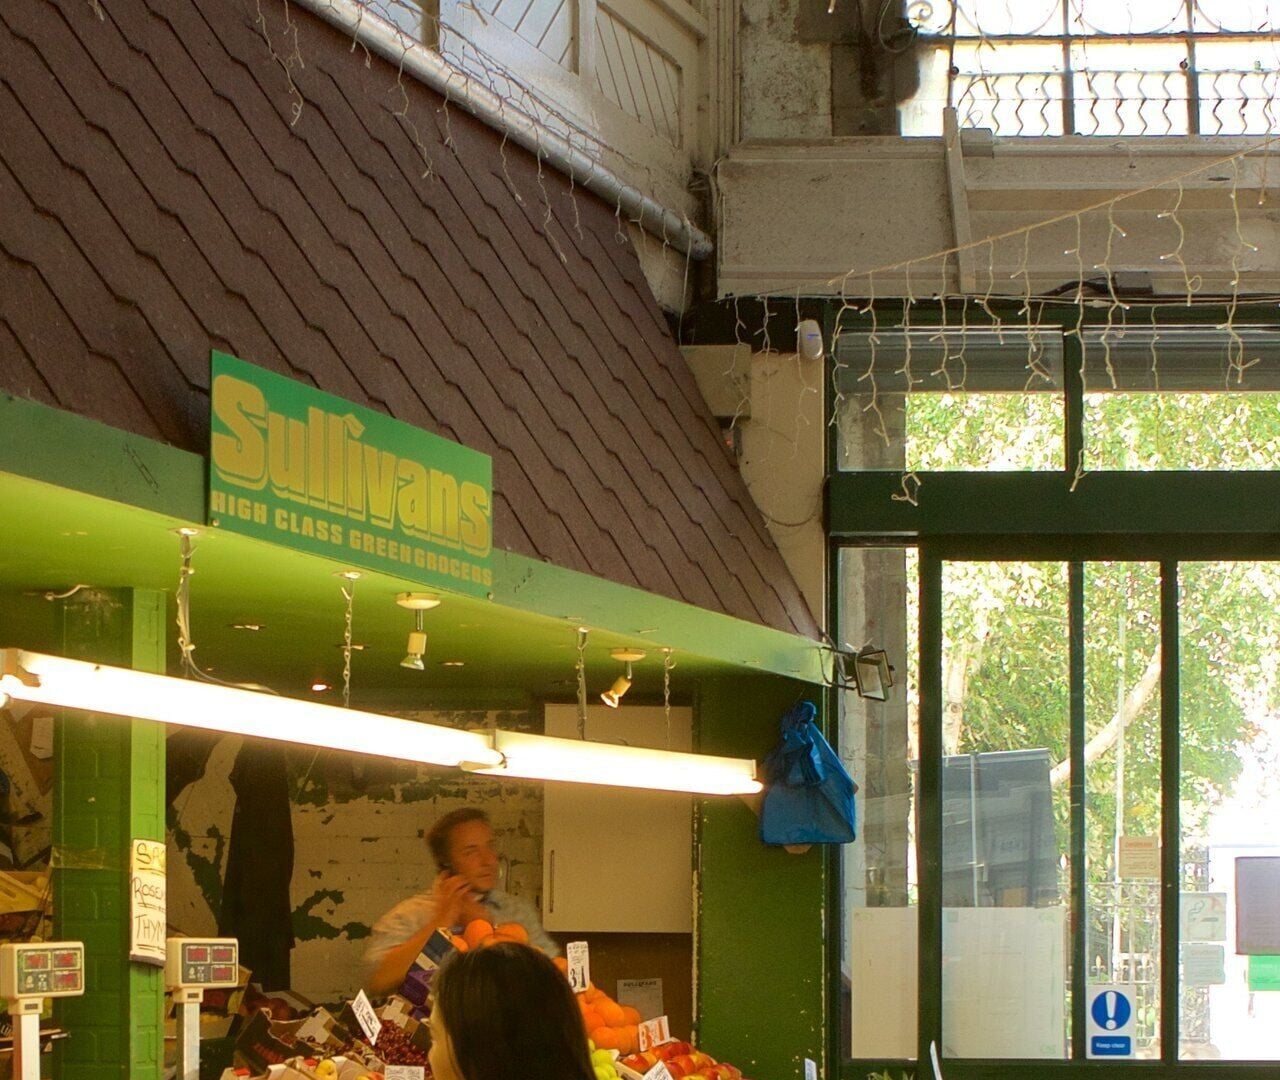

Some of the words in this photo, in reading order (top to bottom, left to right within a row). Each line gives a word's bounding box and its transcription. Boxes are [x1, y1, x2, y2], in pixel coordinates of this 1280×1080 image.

[212, 374, 493, 558] Sullivans
[211, 489, 267, 525] HIGH
[274, 508, 343, 546] CLASS
[349, 529, 411, 564] GREEN
[414, 547, 493, 587] GROCERS
